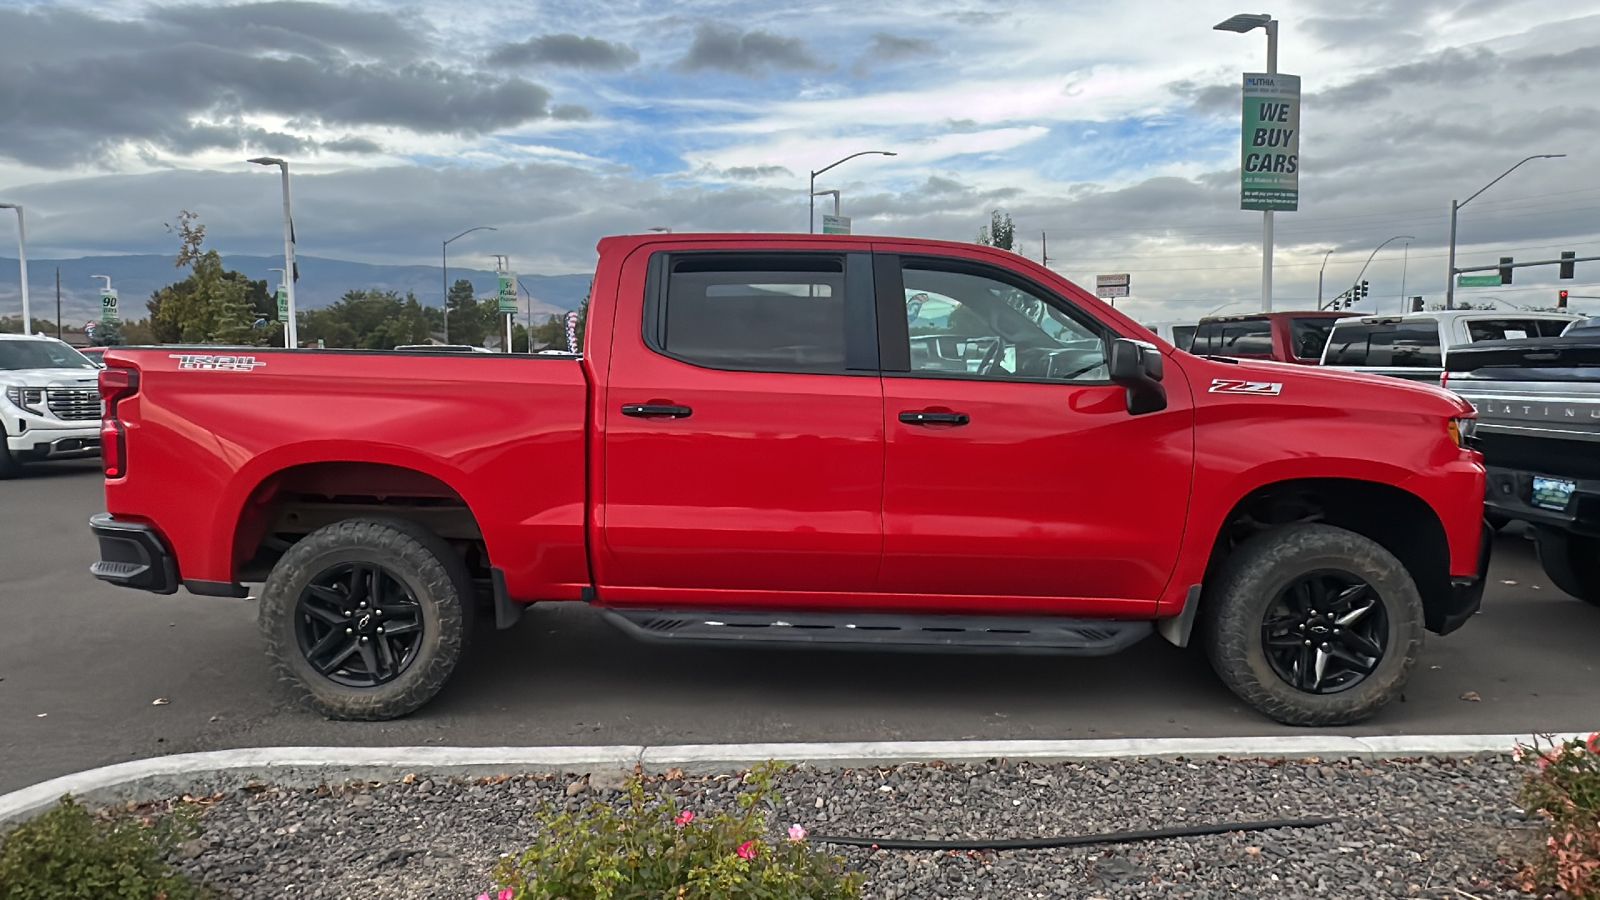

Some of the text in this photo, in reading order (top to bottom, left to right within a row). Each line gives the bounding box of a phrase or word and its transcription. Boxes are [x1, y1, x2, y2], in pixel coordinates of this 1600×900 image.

[1252, 78, 1275, 86] LITHIA
[1259, 103, 1290, 122] WE
[1252, 128, 1294, 147] BUY
[1244, 153, 1298, 174] CARS
[102, 297, 117, 307] 90
[168, 354, 267, 366] TRAIL
[178, 362, 254, 372] BOSS
[1208, 378, 1283, 396] Z71
